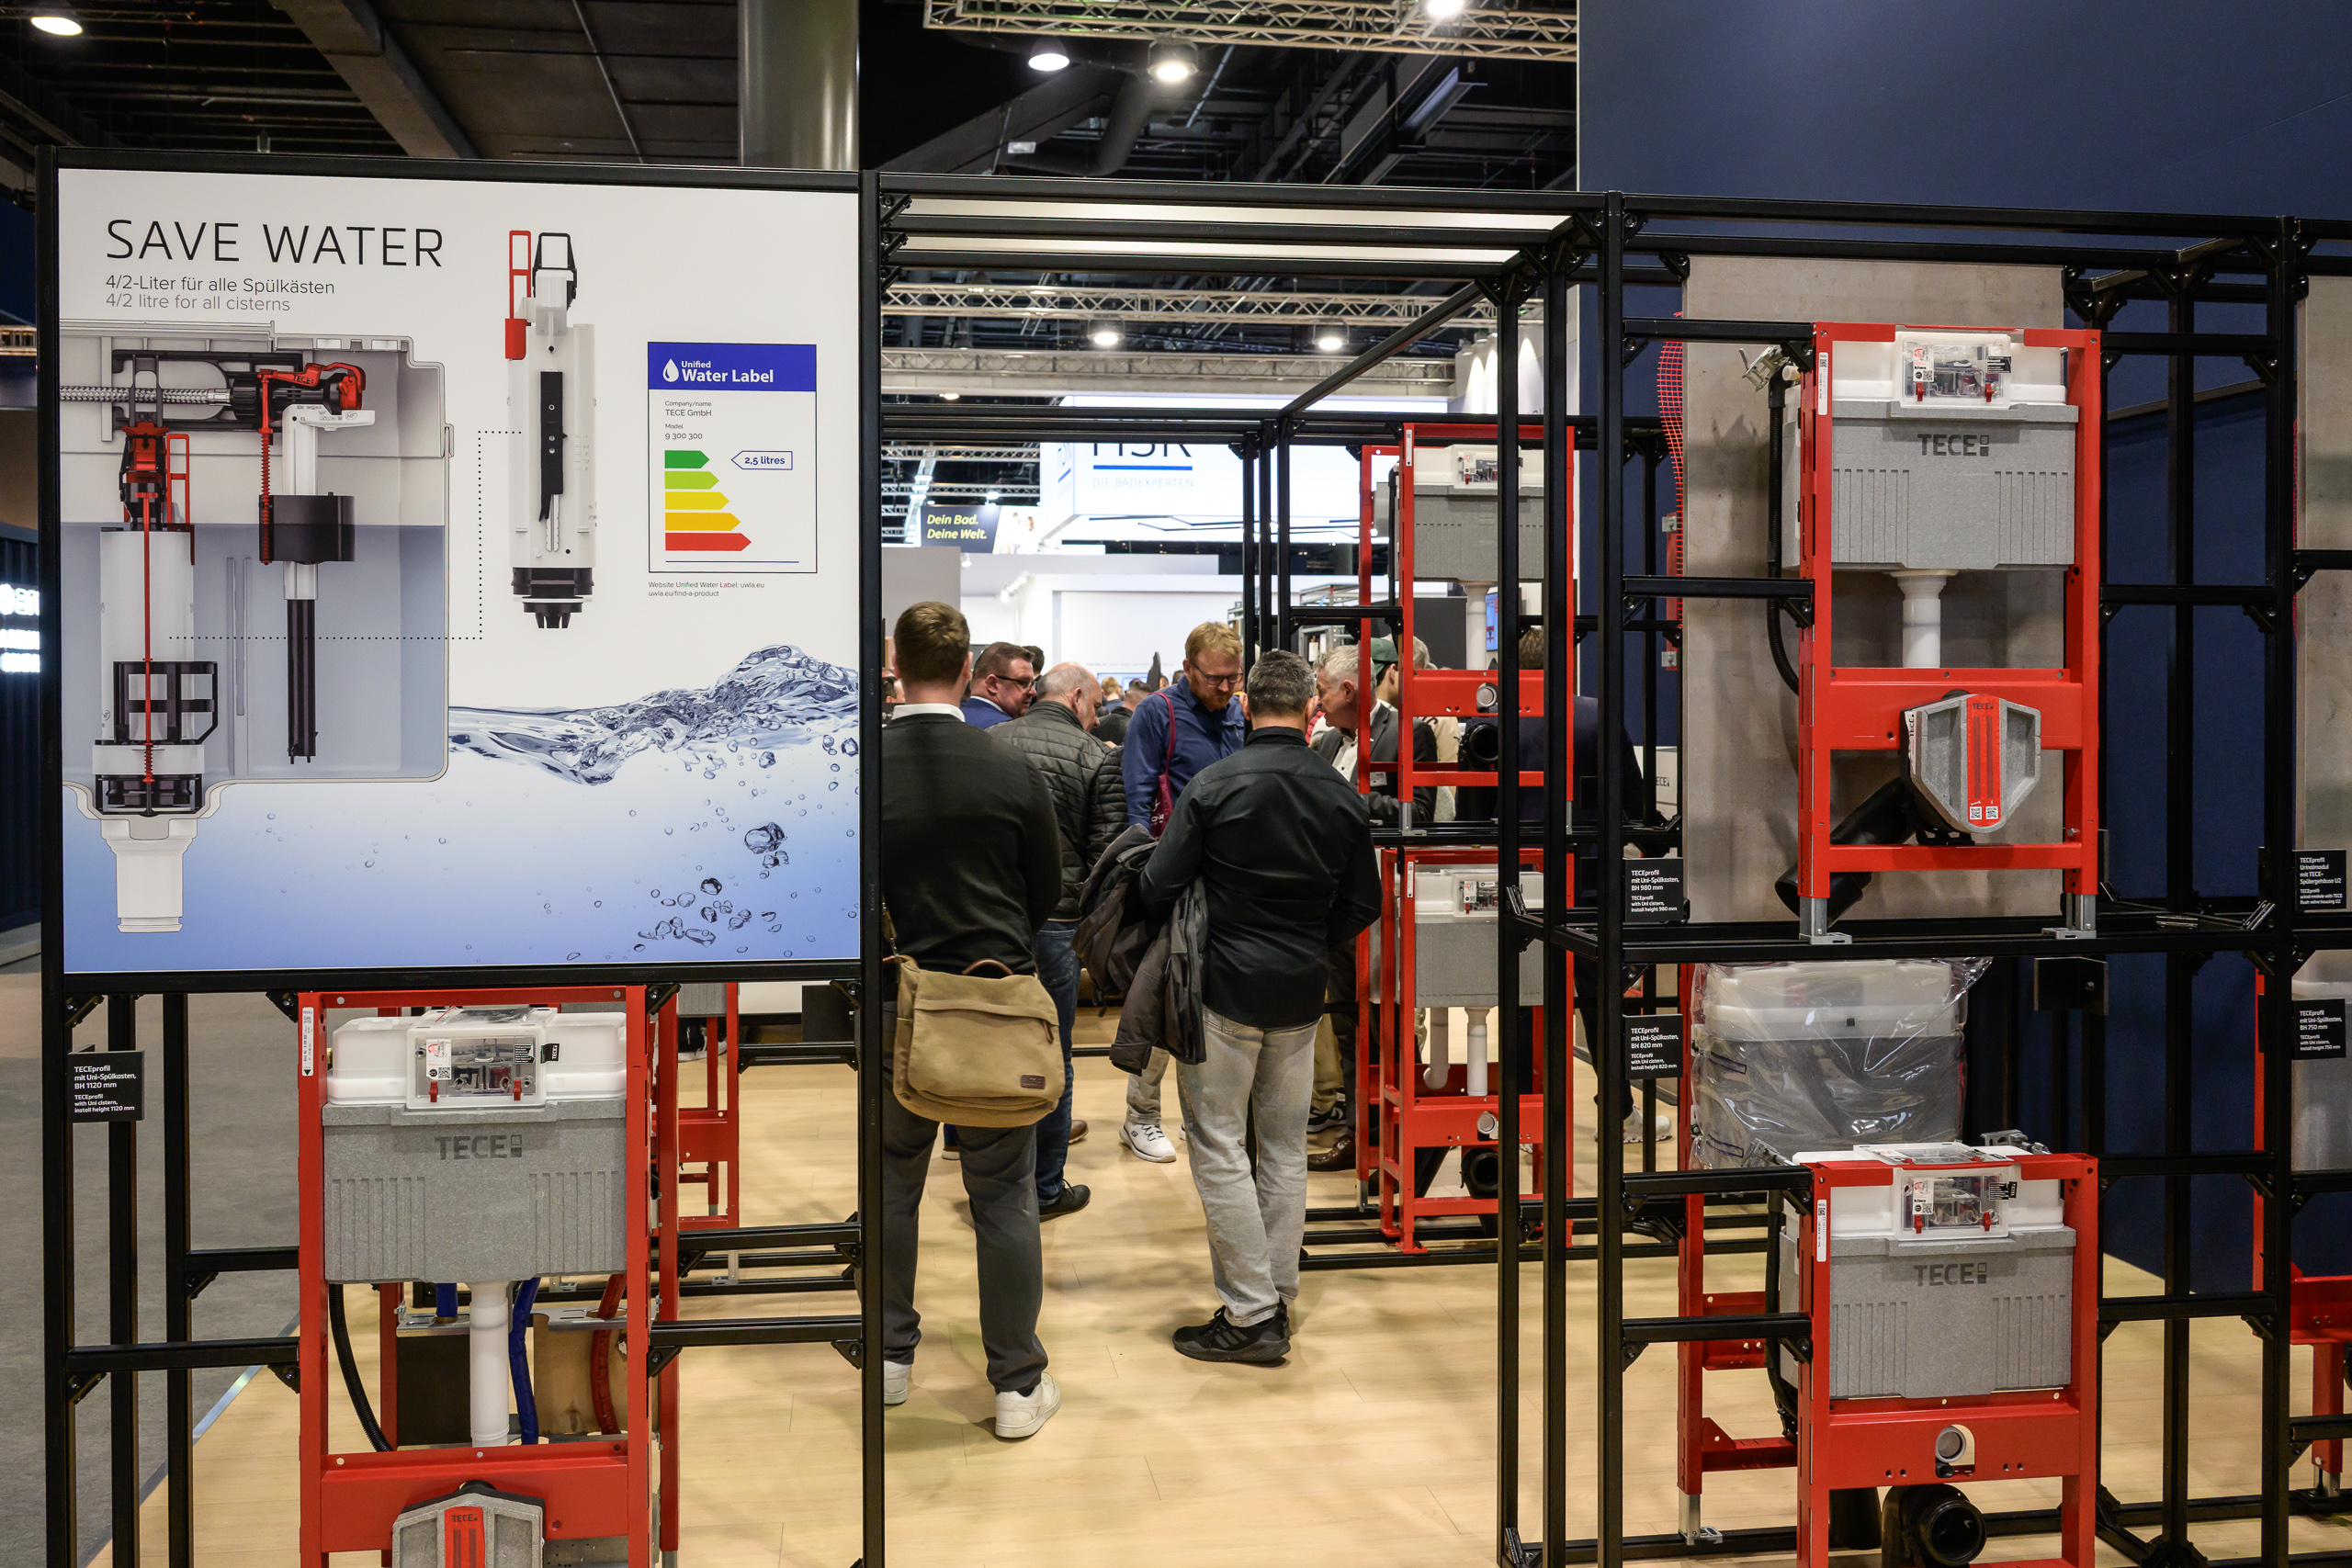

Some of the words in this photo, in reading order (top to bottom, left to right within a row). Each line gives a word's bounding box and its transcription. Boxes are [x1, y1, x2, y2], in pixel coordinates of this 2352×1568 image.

[106, 219, 240, 261] SAVE
[263, 223, 444, 267] WATER
[106, 274, 175, 291] 4/2-Liter
[181, 276, 203, 291] für
[209, 277, 237, 292] alle
[243, 278, 334, 296] Spülkästen
[106, 293, 132, 308] 4/2
[139, 294, 169, 308] litre
[175, 294, 197, 309] for
[203, 295, 220, 310] all
[226, 296, 290, 311] cisterns
[681, 360, 711, 368] Unified
[682, 369, 728, 383] Water
[732, 369, 774, 383] Label
[1917, 434, 1978, 457] TECE
[744, 456, 758, 466] 2,5
[760, 456, 785, 465] litres
[1092, 477, 1111, 487] DIE
[1115, 478, 1194, 488] BADEXPERTEN
[926, 513, 951, 526] Dein
[953, 513, 979, 526] Bad.
[927, 527, 958, 540] Deine
[960, 527, 988, 540] Welt.
[1656, 776, 1667, 787] ECE
[434, 1134, 507, 1161] TECE
[1913, 1263, 1976, 1287] TECE
[452, 1514, 474, 1522] TECE
